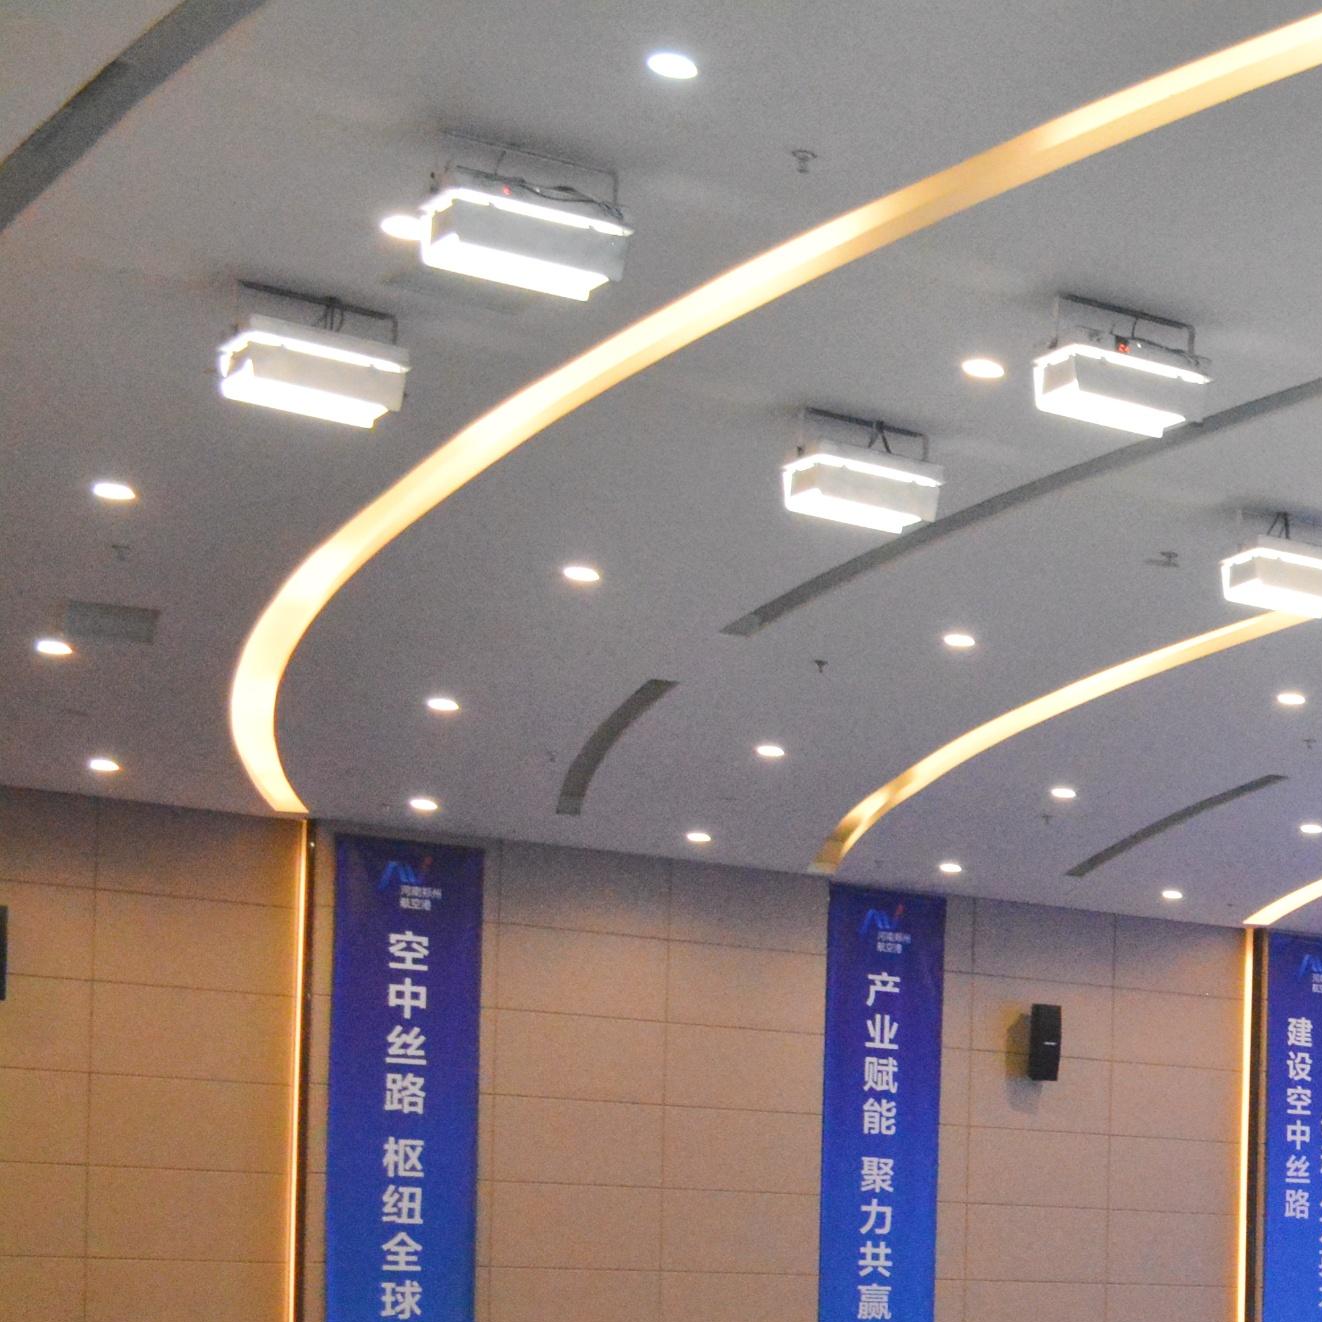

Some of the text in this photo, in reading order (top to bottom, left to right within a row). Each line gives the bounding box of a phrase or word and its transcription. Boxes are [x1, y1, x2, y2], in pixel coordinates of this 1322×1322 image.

[380, 930, 429, 1320] 空中丝路 枢纽全球
[857, 971, 901, 1320] 产业赋能 聚力共赢
[1284, 1016, 1314, 1220] 建设空中丝路
